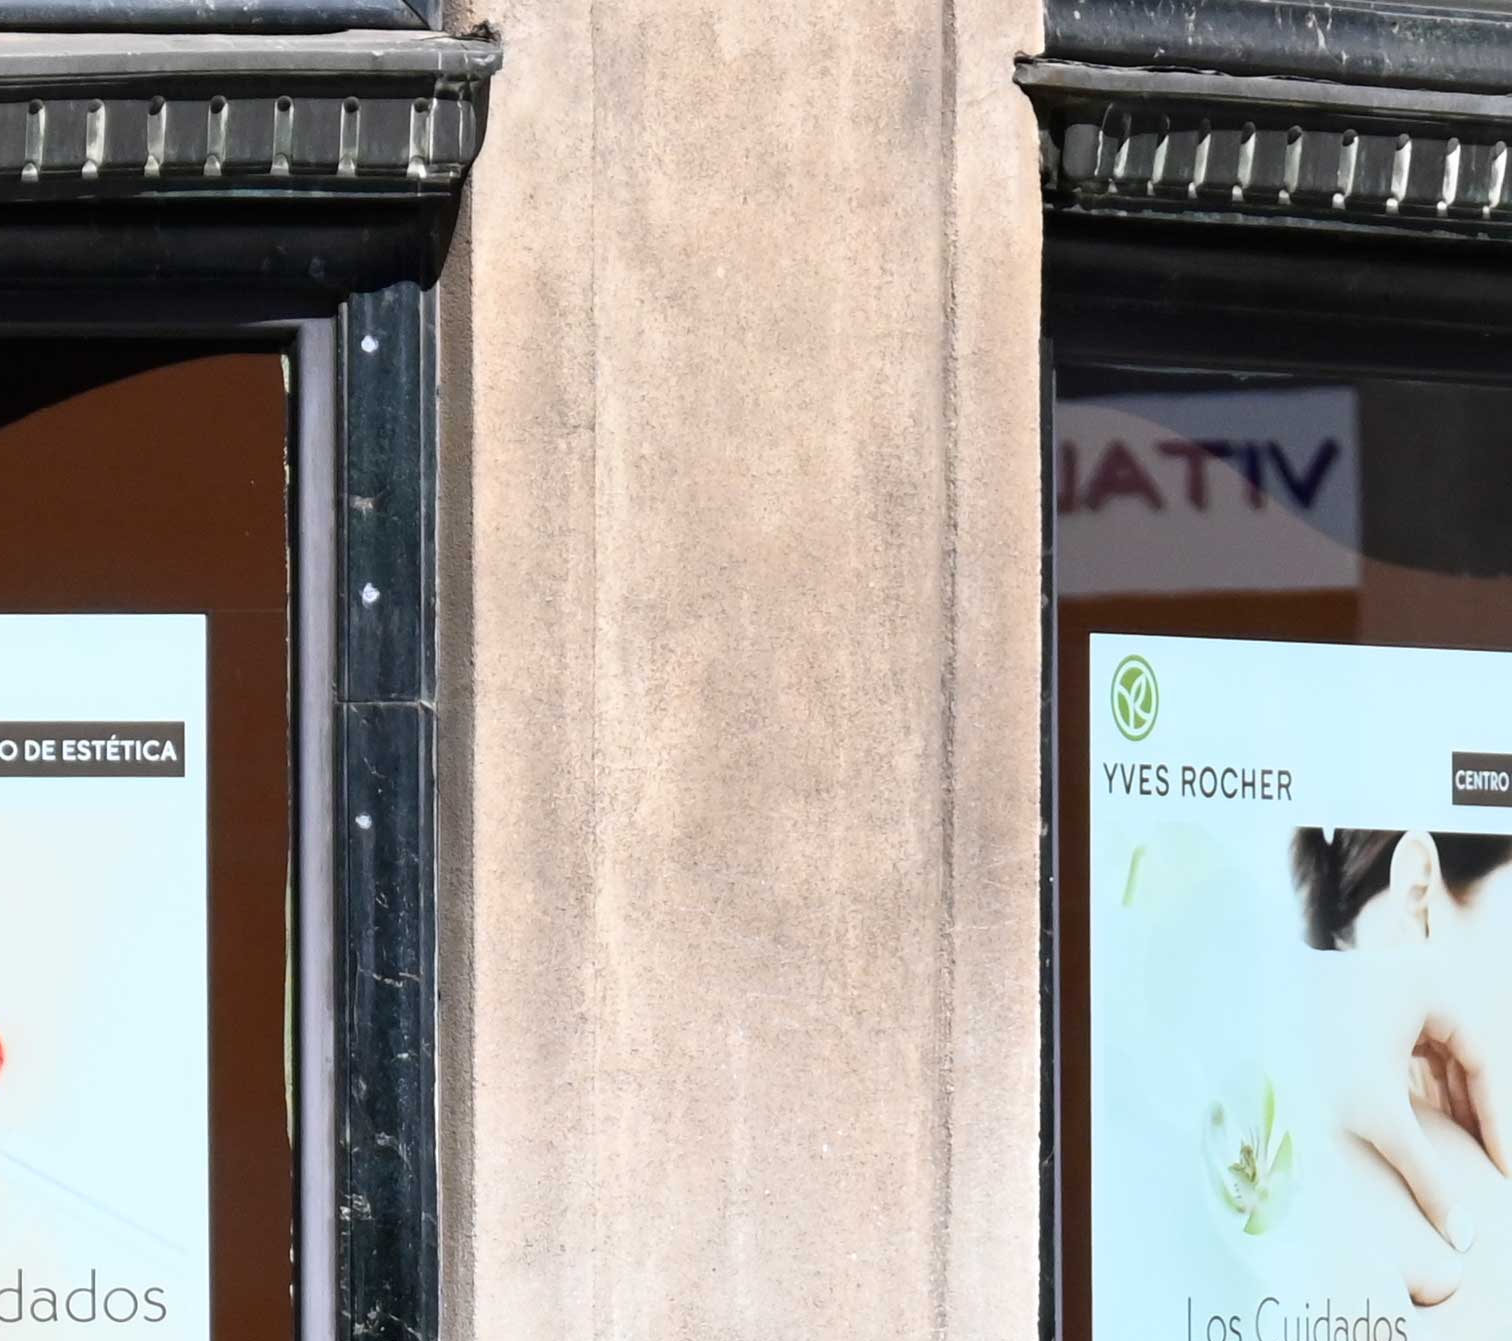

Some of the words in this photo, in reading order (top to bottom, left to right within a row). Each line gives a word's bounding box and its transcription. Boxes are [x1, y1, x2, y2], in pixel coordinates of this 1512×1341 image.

[25, 740, 56, 761] DE
[63, 734, 177, 761] ESTÉTICA
[1103, 763, 1169, 796] YVES
[1182, 766, 1291, 800] ROCHER
[1455, 770, 1509, 792] CENTRO
